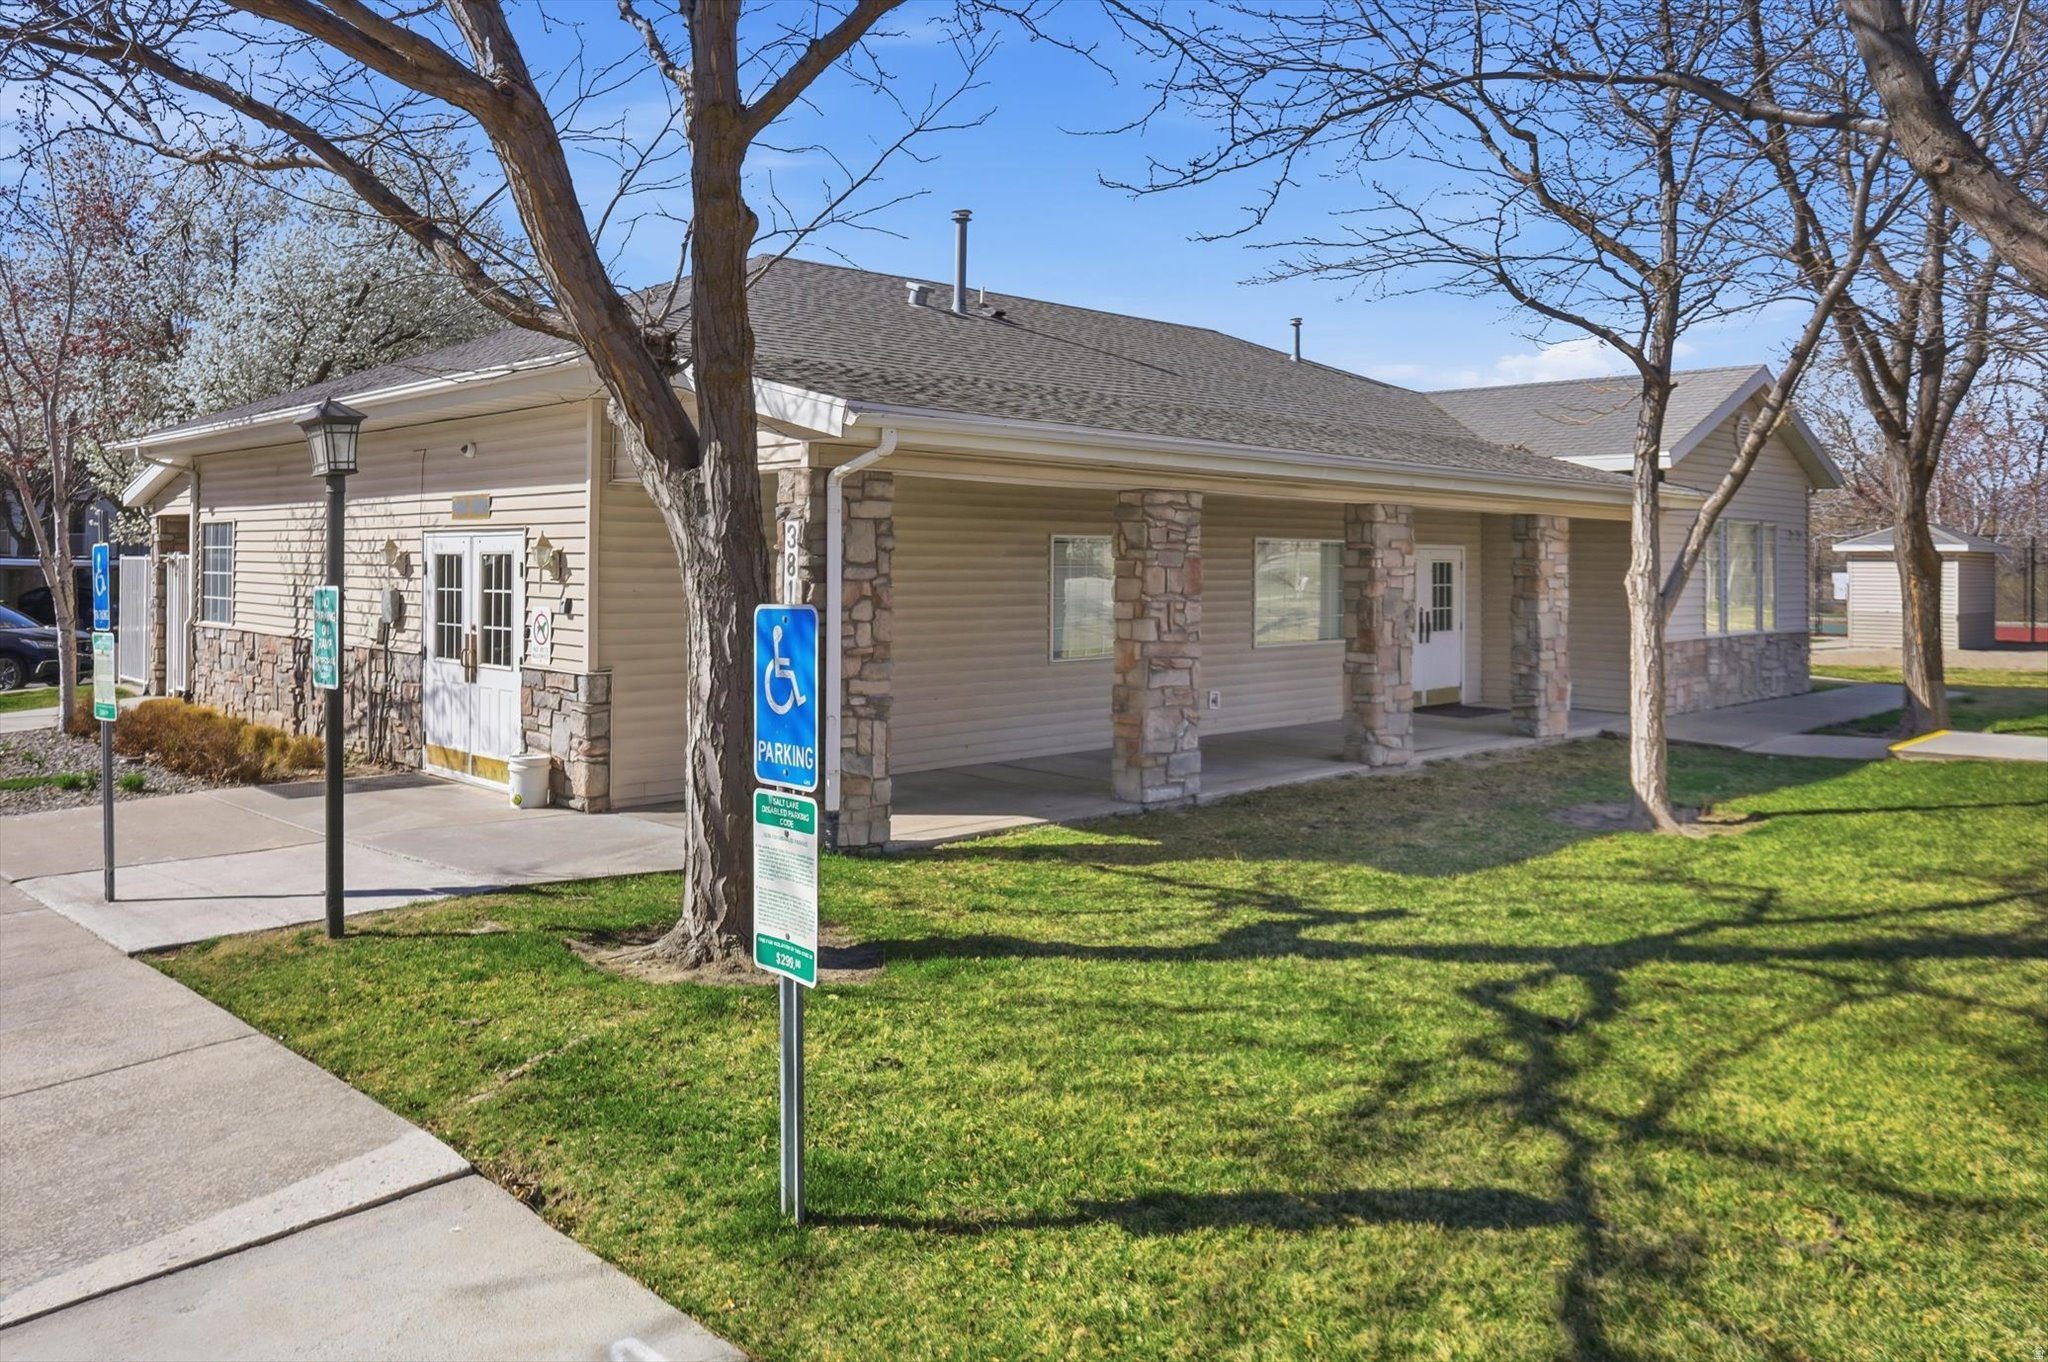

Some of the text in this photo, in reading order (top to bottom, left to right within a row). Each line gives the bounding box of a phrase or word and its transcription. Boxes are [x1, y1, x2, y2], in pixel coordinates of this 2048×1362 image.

[758, 740, 813, 770] PARKING
[772, 797, 785, 807] SALT
[761, 805, 809, 822] DISABLED PARKING
[780, 818, 794, 829] CODE
